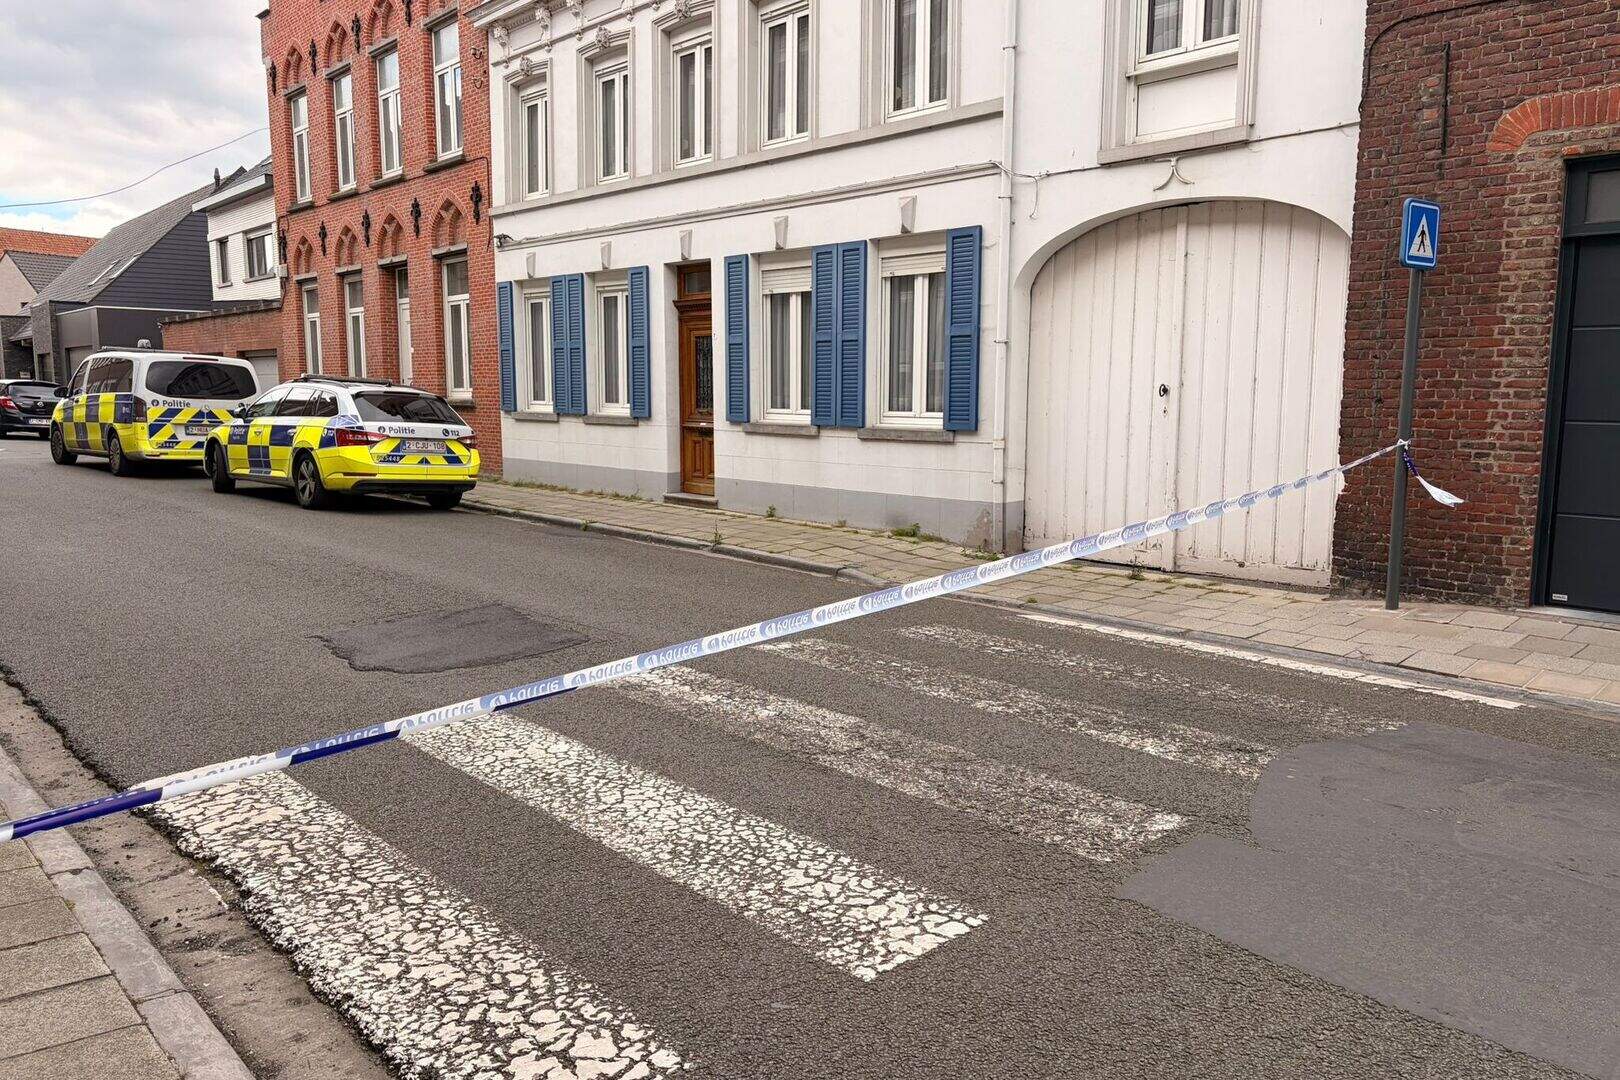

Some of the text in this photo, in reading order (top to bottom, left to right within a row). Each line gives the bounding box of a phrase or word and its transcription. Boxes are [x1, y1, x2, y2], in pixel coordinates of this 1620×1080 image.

[162, 399, 191, 408] Politie
[388, 426, 460, 437] Politie 112
